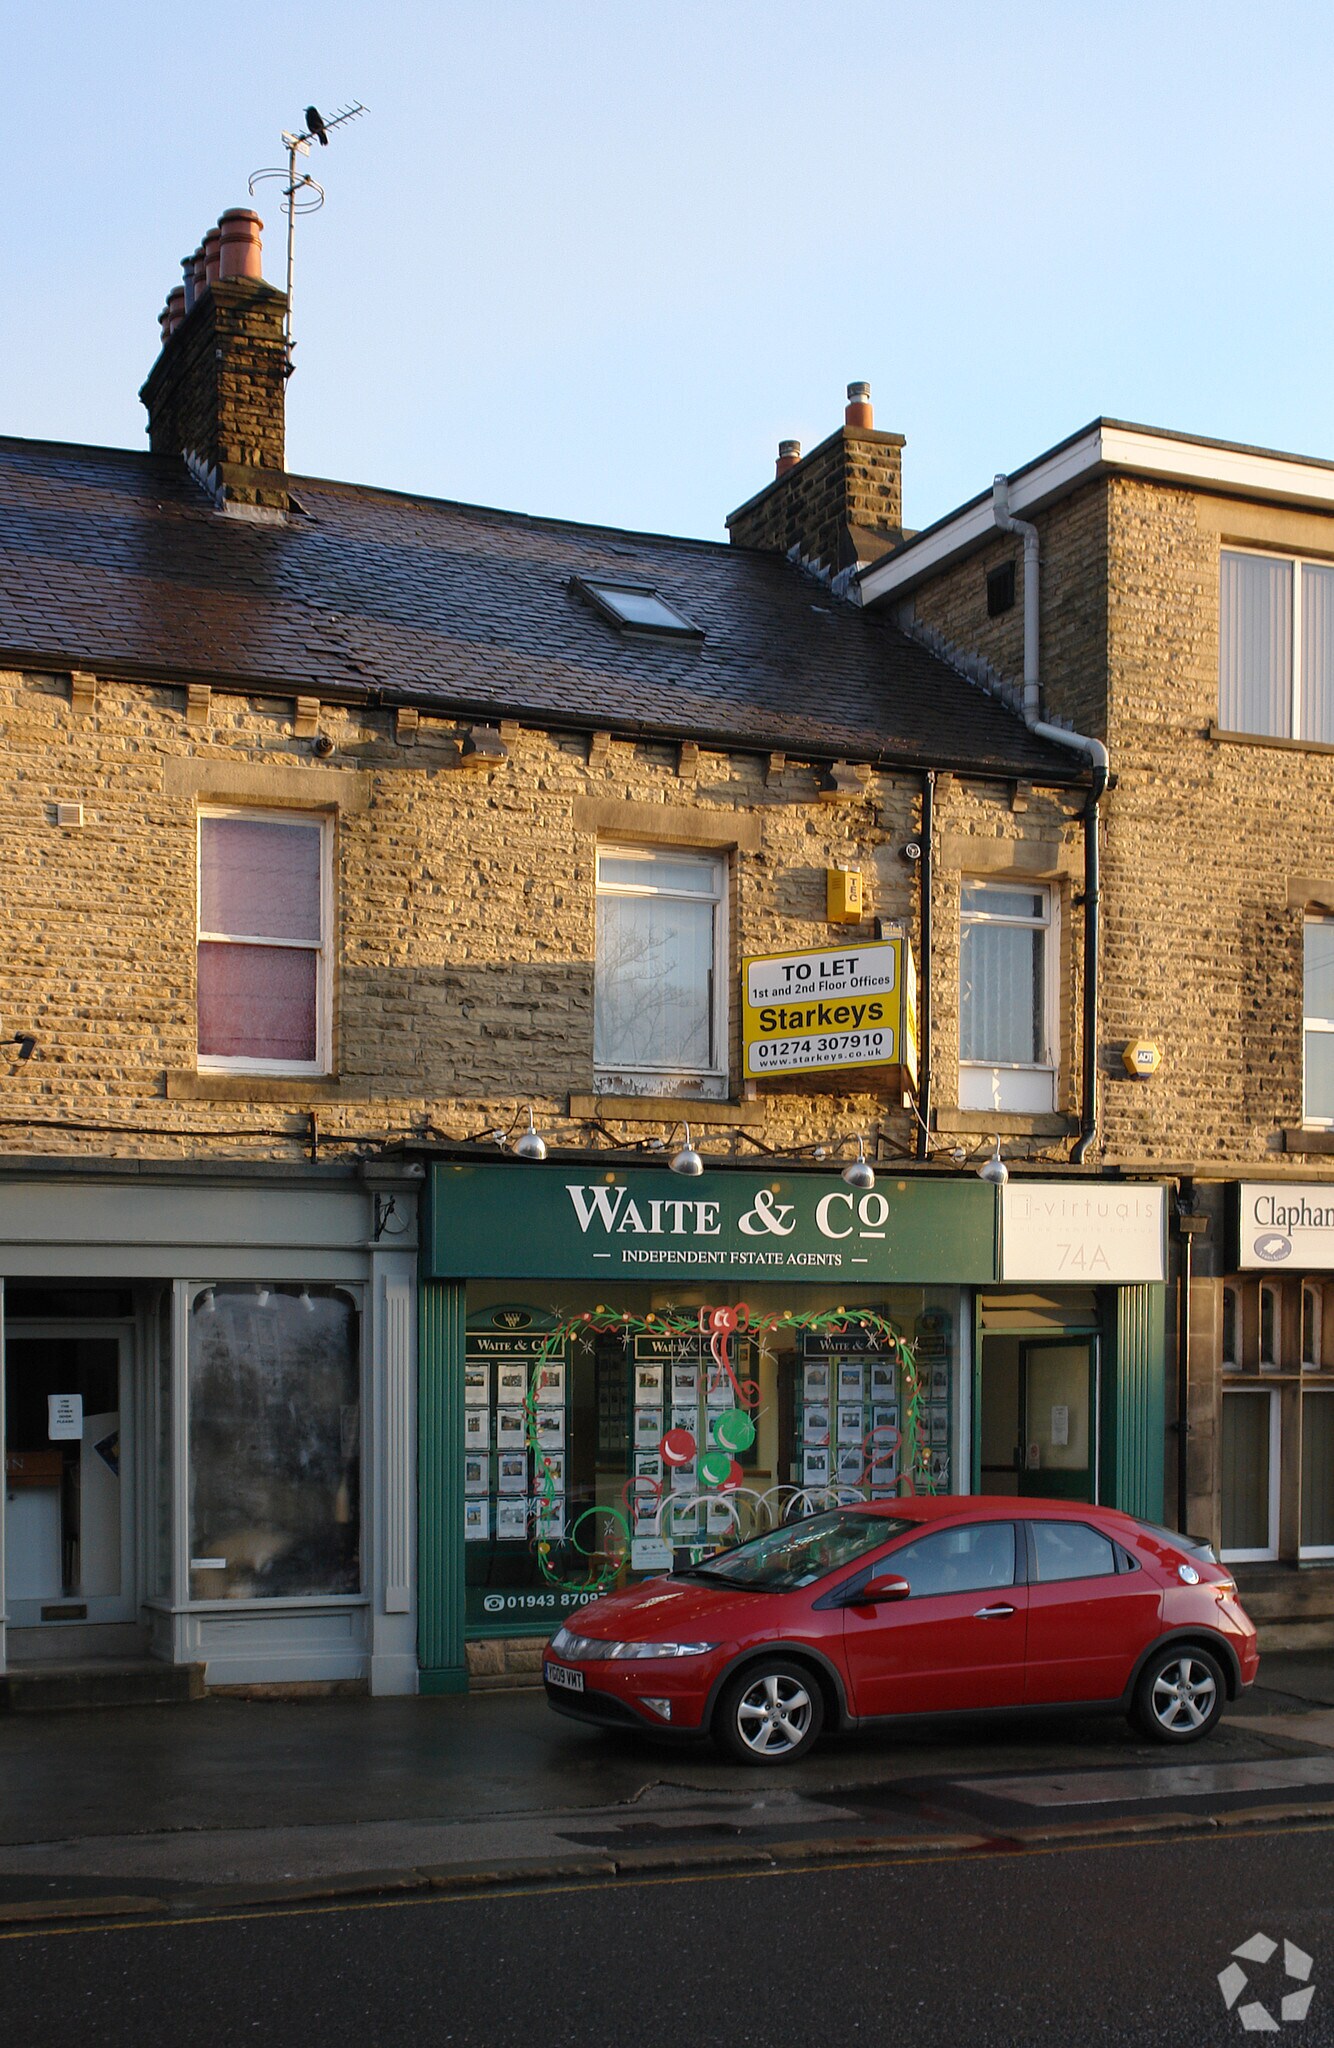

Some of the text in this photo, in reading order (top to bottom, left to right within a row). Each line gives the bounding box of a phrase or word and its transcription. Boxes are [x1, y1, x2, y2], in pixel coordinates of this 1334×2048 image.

[782, 958, 859, 981] TO LET
[752, 976, 890, 998] 1st and 2nd Floor Offices
[759, 1002, 884, 1032] Starkeys
[758, 1033, 883, 1057] 01274 307910
[759, 1047, 882, 1067] www.starkeys.co.uk
[1138, 1051, 1153, 1063] ADT
[737, 1189, 797, 1236] &
[621, 1250, 727, 1263] INDEPENDENT
[786, 1253, 842, 1266] AGENTS
[1056, 1244, 1111, 1271] 74A
[514, 1340, 528, 1351] &
[507, 1592, 608, 1608] 01943 8709
